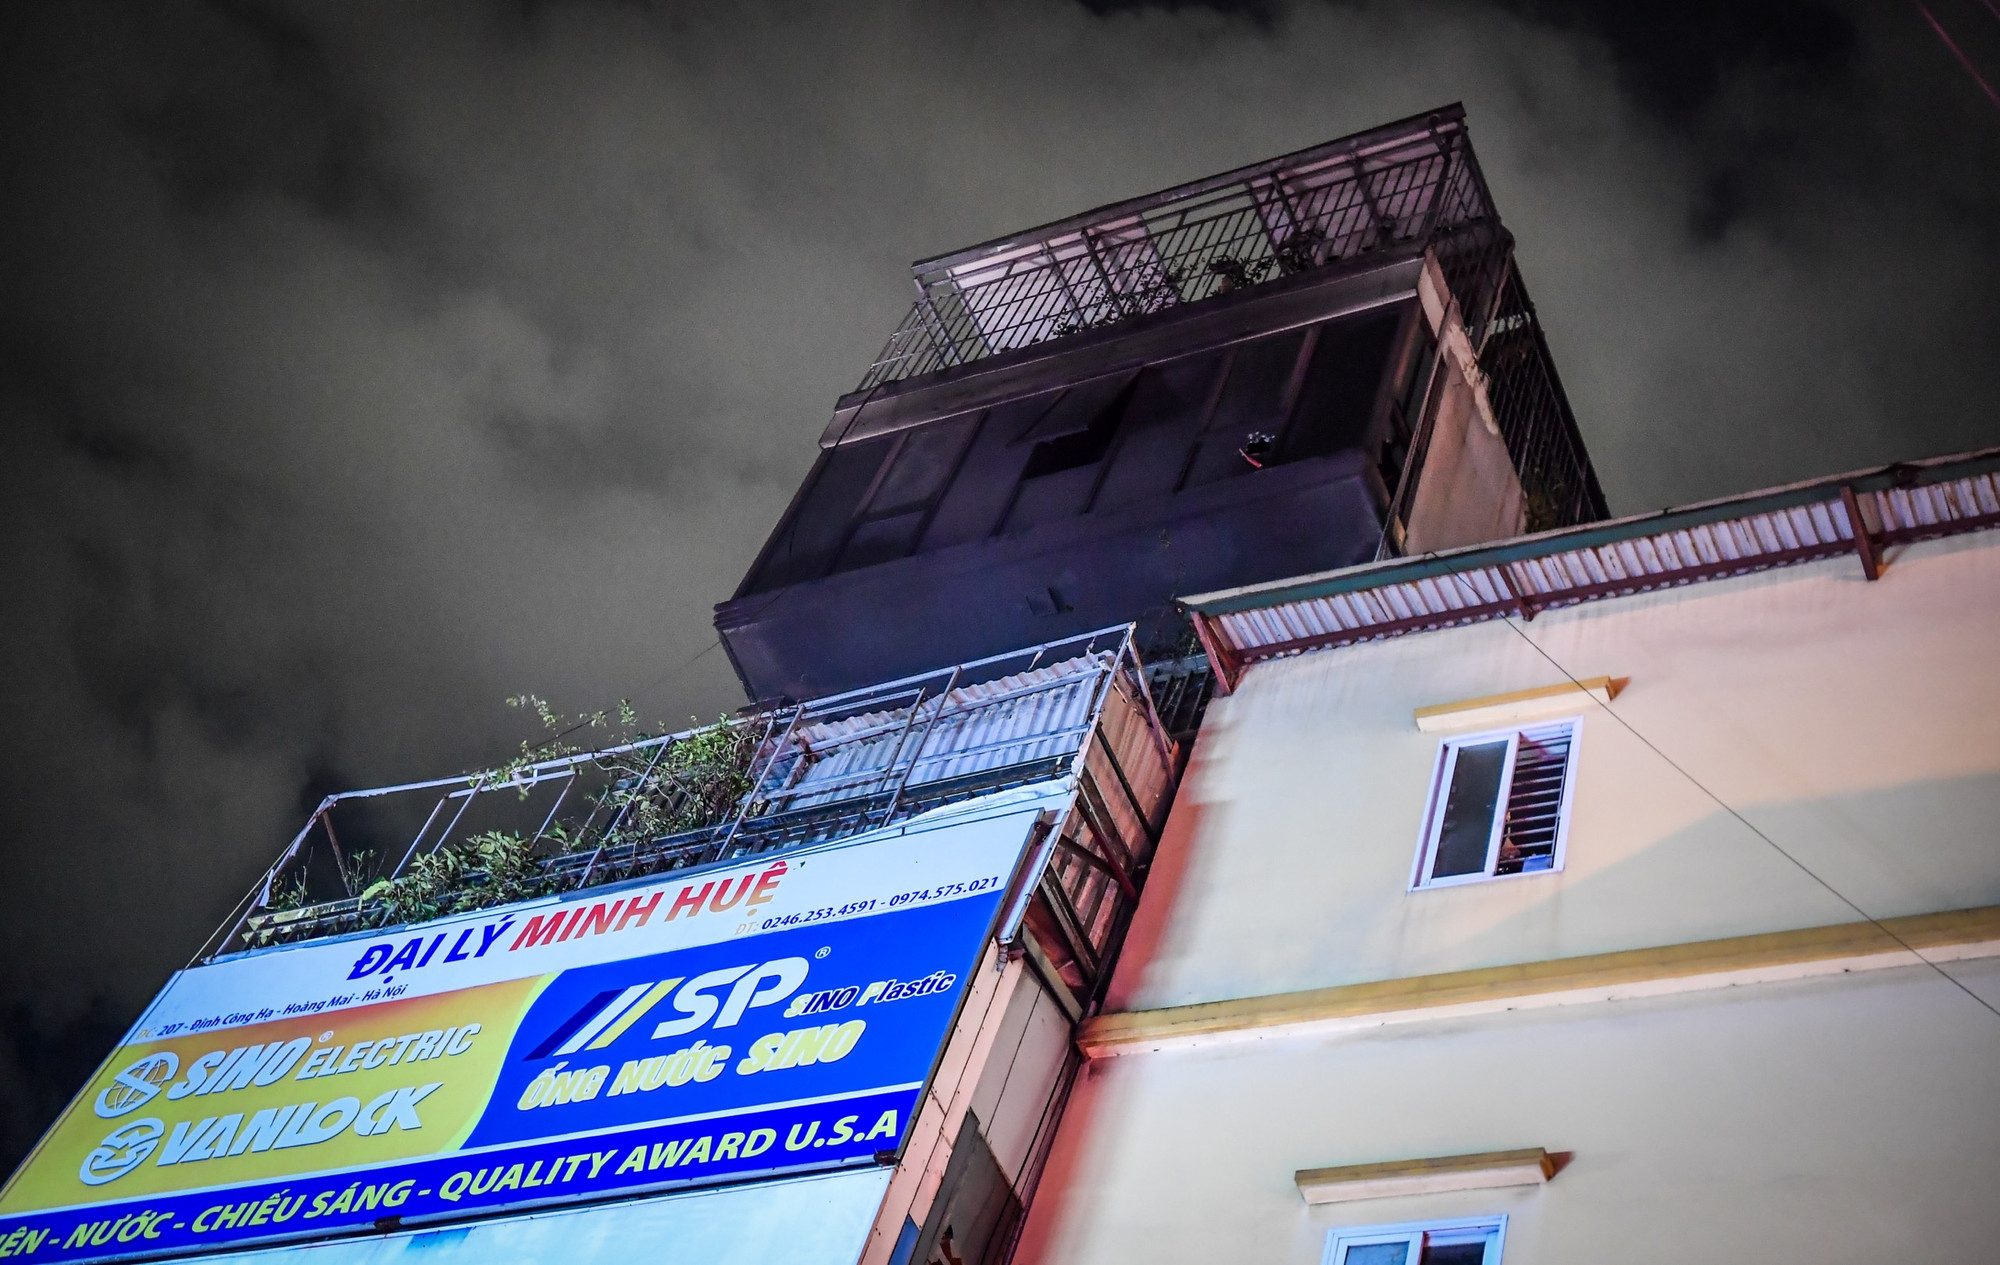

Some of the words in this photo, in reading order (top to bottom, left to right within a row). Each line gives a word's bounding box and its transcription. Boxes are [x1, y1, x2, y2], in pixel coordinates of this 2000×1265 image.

[346, 937, 434, 984] ĐẠI
[443, 913, 516, 964] LÝ
[508, 892, 663, 952] MINH
[665, 861, 788, 922] HUỆ
[762, 899, 877, 930] 0246.253.4591
[889, 876, 999, 907] 0974.575.021
[156, 1022, 185, 1036] 207
[189, 1016, 222, 1032] Định
[221, 1012, 255, 1026] Công
[255, 1008, 275, 1021] Hạ
[282, 1000, 327, 1016] Hoàng
[327, 993, 356, 1008] Mai
[361, 987, 381, 1002] Hà
[383, 984, 409, 1000] Nội
[651, 956, 810, 1041] SP
[783, 985, 860, 1018] SINO
[856, 970, 957, 1007] Plastic
[167, 1037, 312, 1100] SINO
[295, 1022, 482, 1082] ELECTRIC
[517, 1061, 611, 1111] ỐNG
[606, 1039, 732, 1097] NƯỚC
[736, 1020, 867, 1076] SINO
[156, 1081, 444, 1167] VANLOCK
[62, 1209, 176, 1249] NƯỚC
[191, 1188, 308, 1233] CHIẾU
[302, 1181, 417, 1220] SÁNG
[438, 1149, 620, 1202] QUALITY
[614, 1127, 777, 1176] AWARD
[785, 1109, 898, 1152] U.S.A
